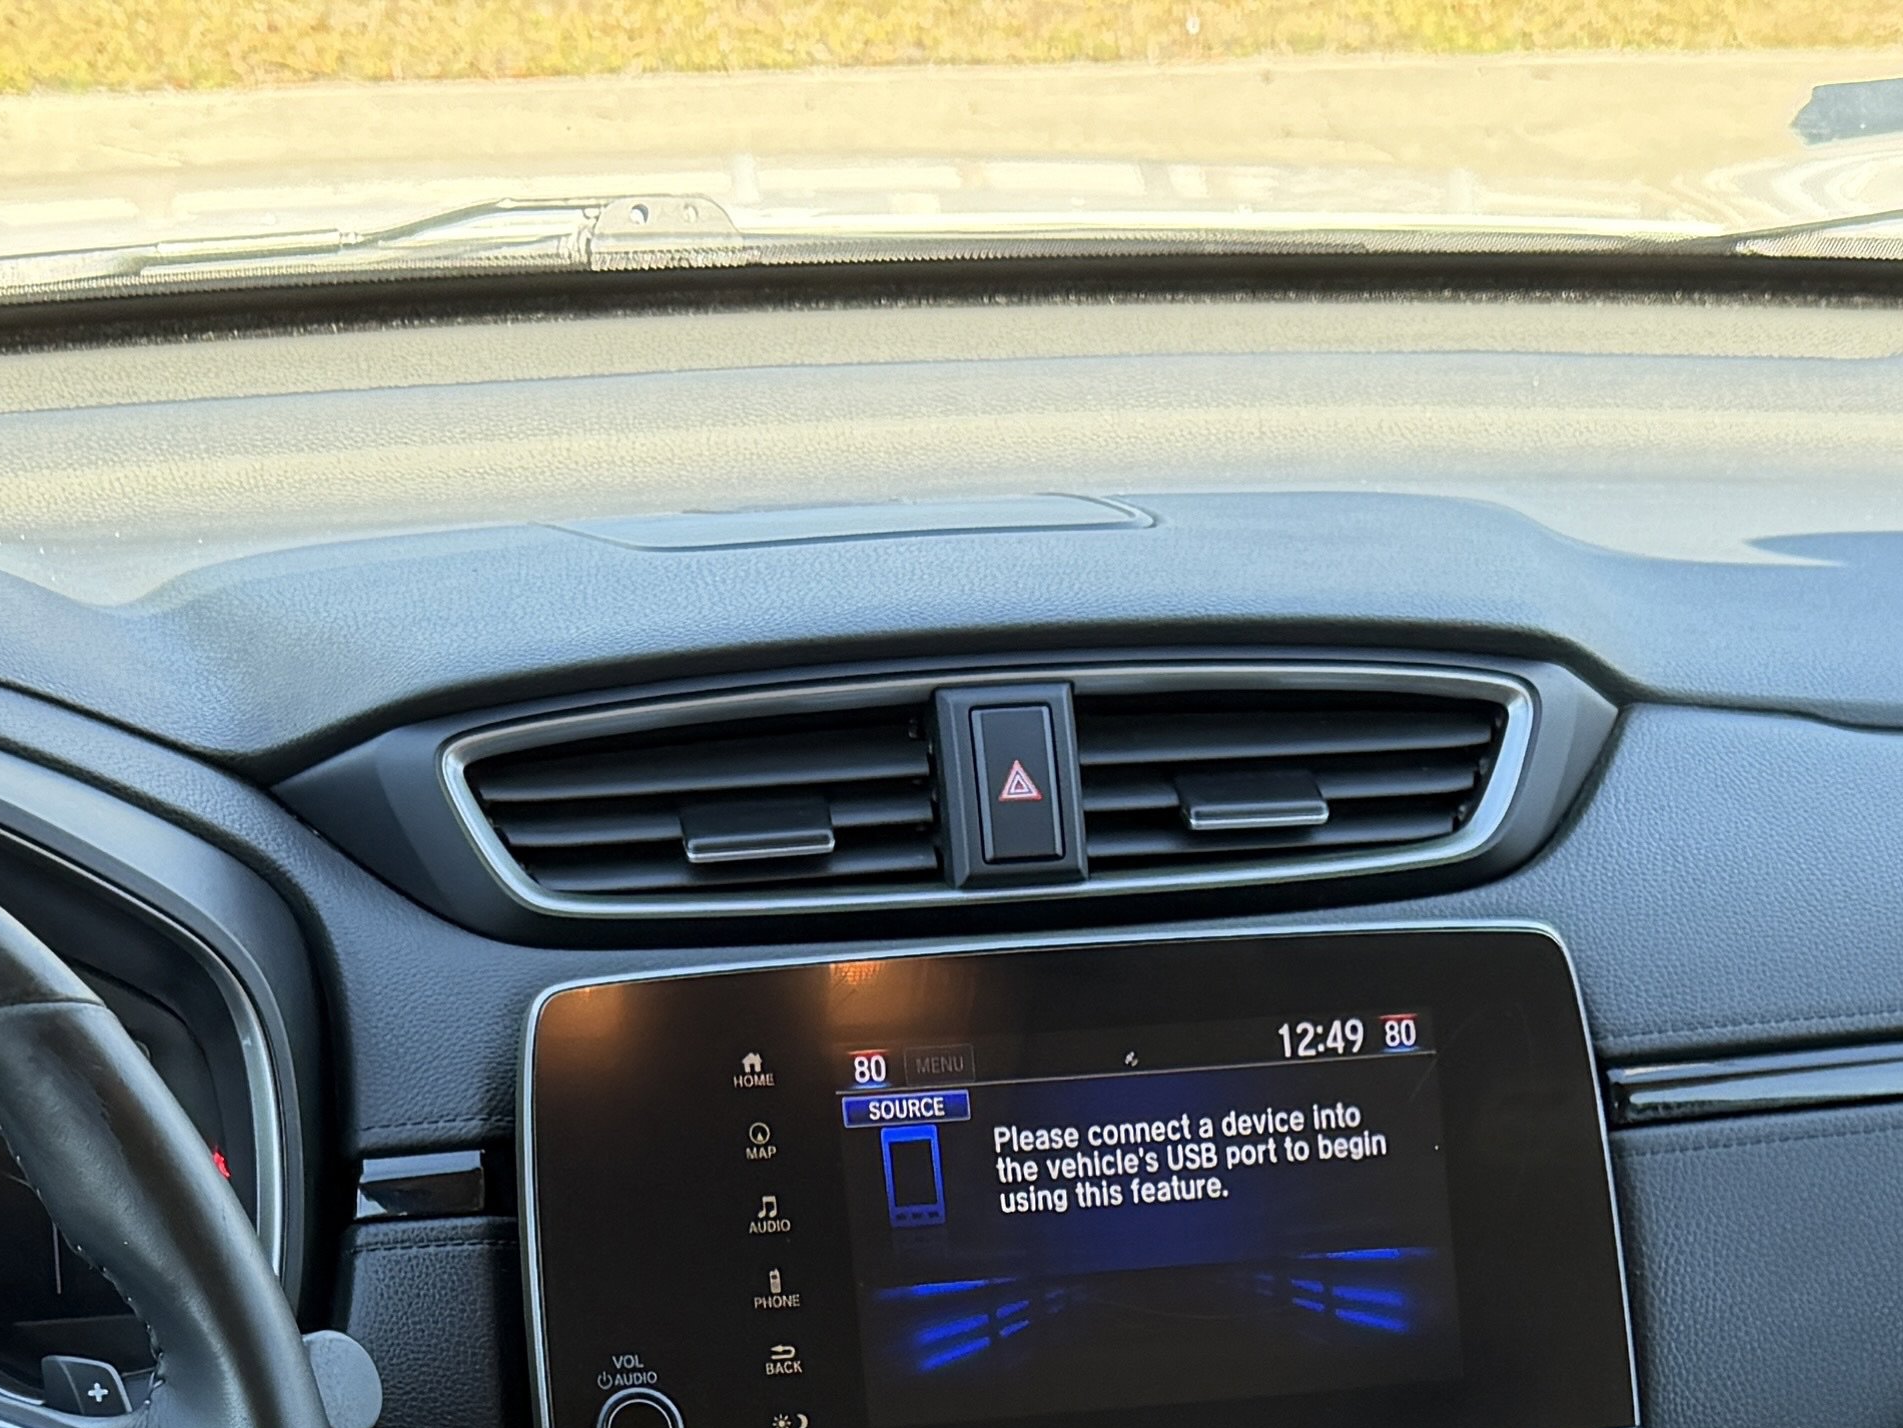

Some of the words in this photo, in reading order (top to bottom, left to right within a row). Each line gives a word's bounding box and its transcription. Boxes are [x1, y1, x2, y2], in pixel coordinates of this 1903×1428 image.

[1278, 1018, 1364, 1059] 12:49
[1384, 1018, 1417, 1048] 80
[853, 1054, 887, 1084] 80
[915, 1056, 965, 1075] MENU
[733, 1073, 776, 1087] HOME
[868, 1097, 945, 1121] SOURCE
[994, 1125, 1079, 1153] Please
[1087, 1113, 1192, 1147] connect
[1198, 1117, 1214, 1138] a
[1221, 1108, 1305, 1137] device
[1312, 1102, 1362, 1130] into
[745, 1146, 777, 1160] MAP
[996, 1155, 1038, 1183] the
[1046, 1145, 1159, 1180] vehicle's
[1167, 1143, 1218, 1172] USB
[1226, 1138, 1278, 1171] port
[1284, 1135, 1309, 1161] to
[1318, 1130, 1388, 1161] begin
[999, 1186, 1068, 1213] using
[1075, 1180, 1123, 1208] this
[1130, 1176, 1229, 1205] feature.
[748, 1219, 791, 1234] AUDIO
[753, 1294, 800, 1309] PHONE
[612, 1355, 644, 1369] VOL
[765, 1360, 802, 1376] BACK
[614, 1370, 658, 1386] AUDIO
